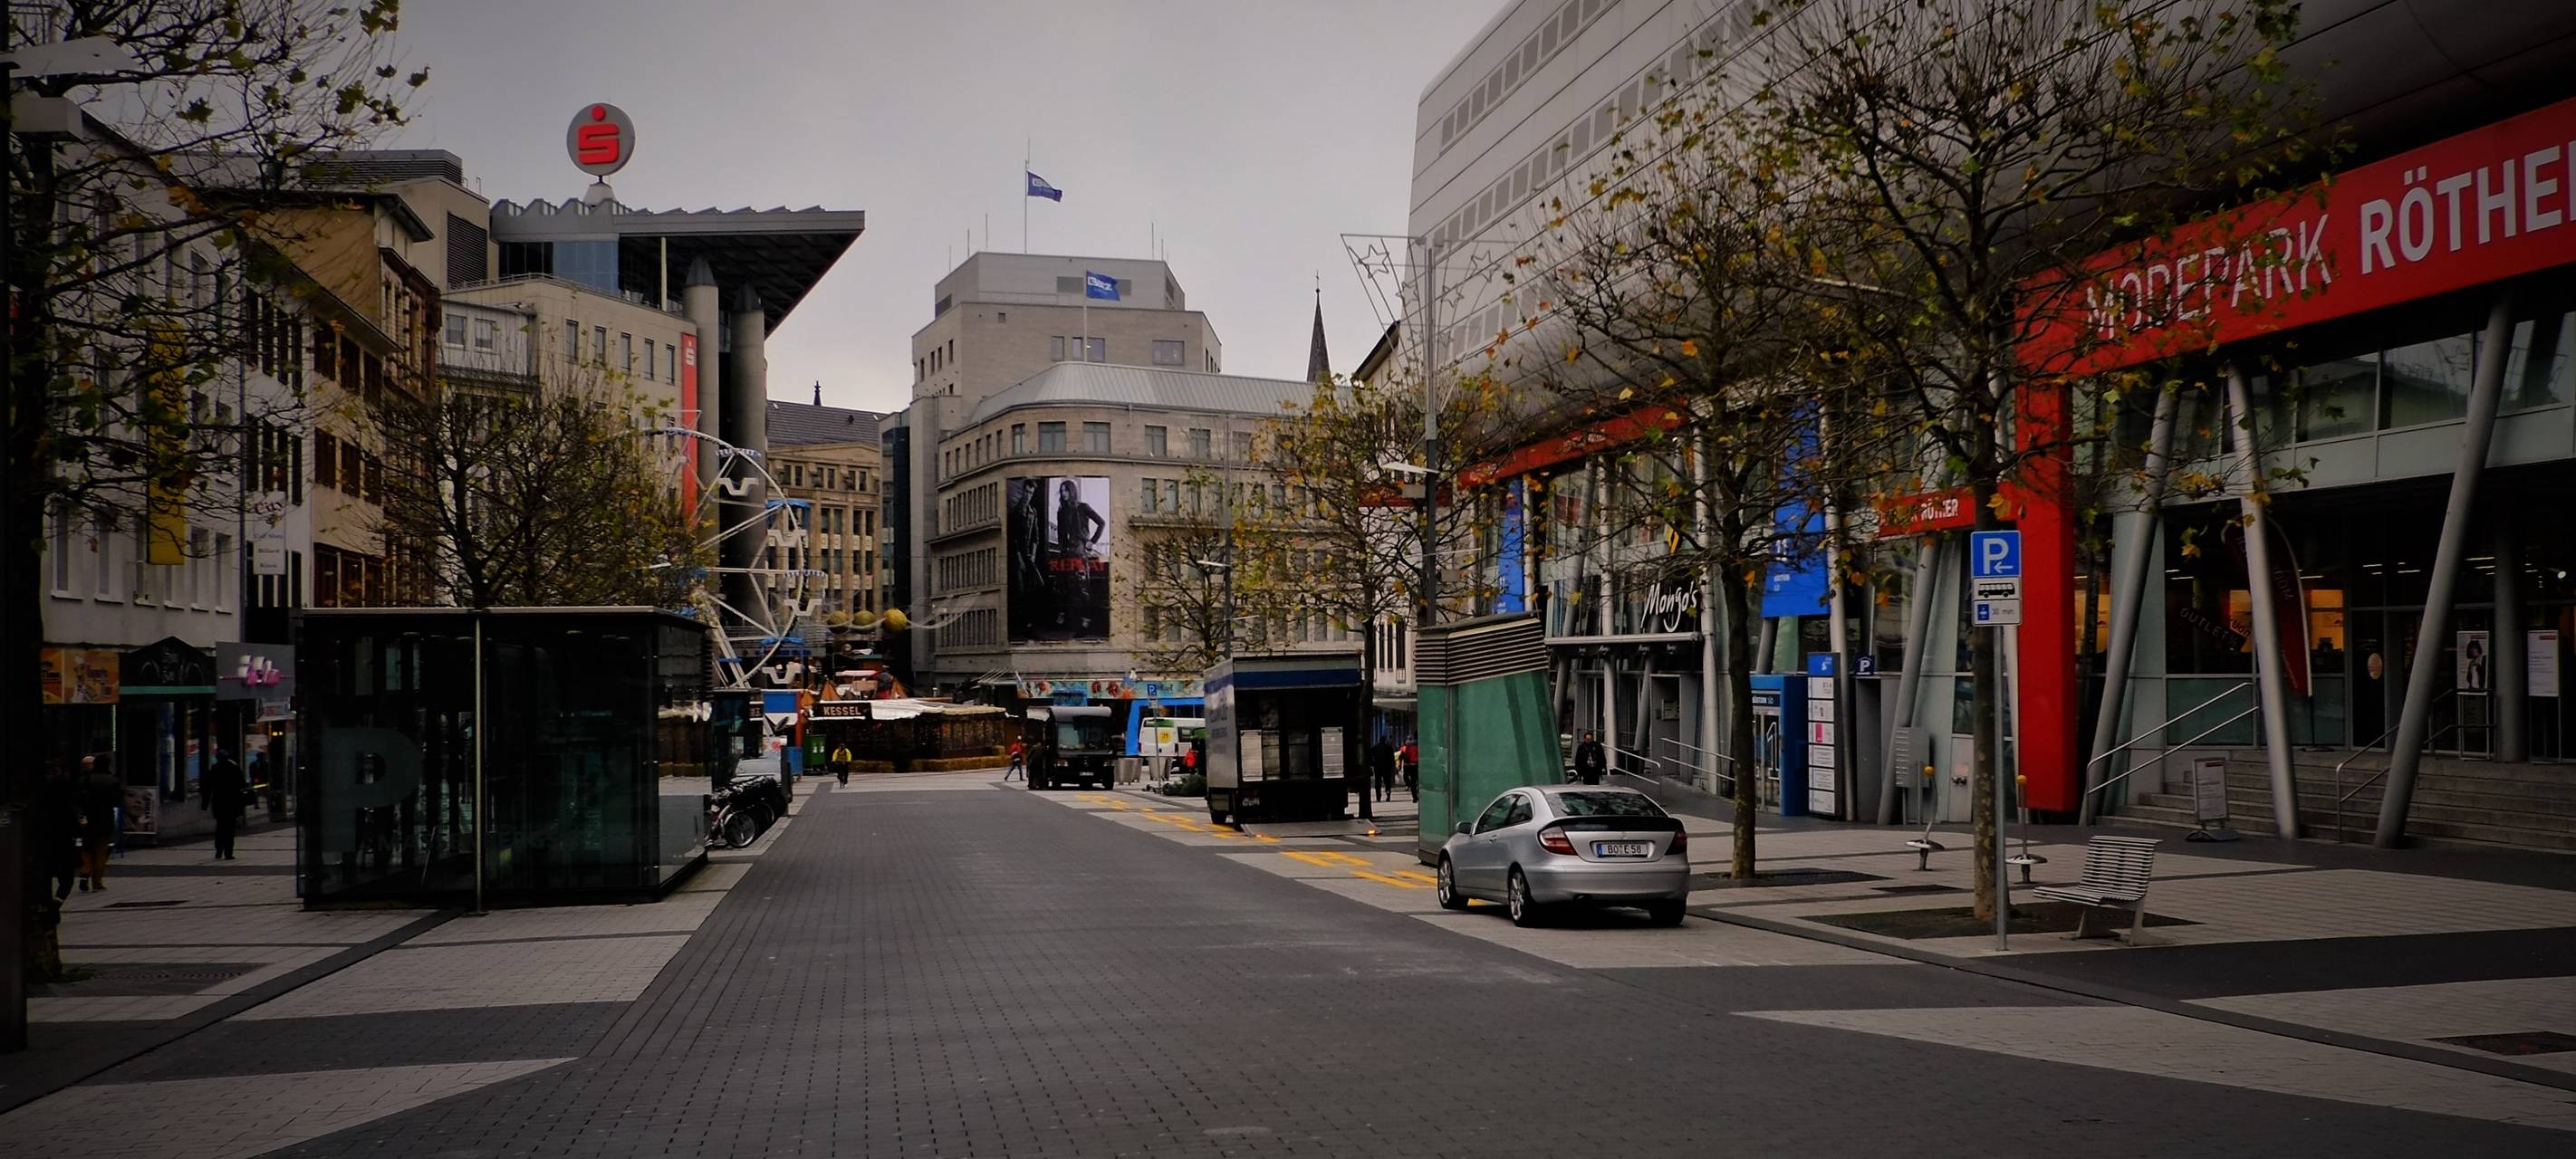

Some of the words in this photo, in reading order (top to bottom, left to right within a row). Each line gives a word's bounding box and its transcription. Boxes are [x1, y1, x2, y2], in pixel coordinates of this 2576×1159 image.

[2085, 214, 2332, 340] MODEPARK
[2360, 139, 2576, 275] RÖTHE
[1983, 538, 2010, 575] P
[1640, 580, 1699, 633] Mongo's
[823, 706, 862, 716] KESSEL
[320, 727, 423, 852] P
[1607, 845, 1619, 854] BO
[1631, 845, 1641, 854] 58
